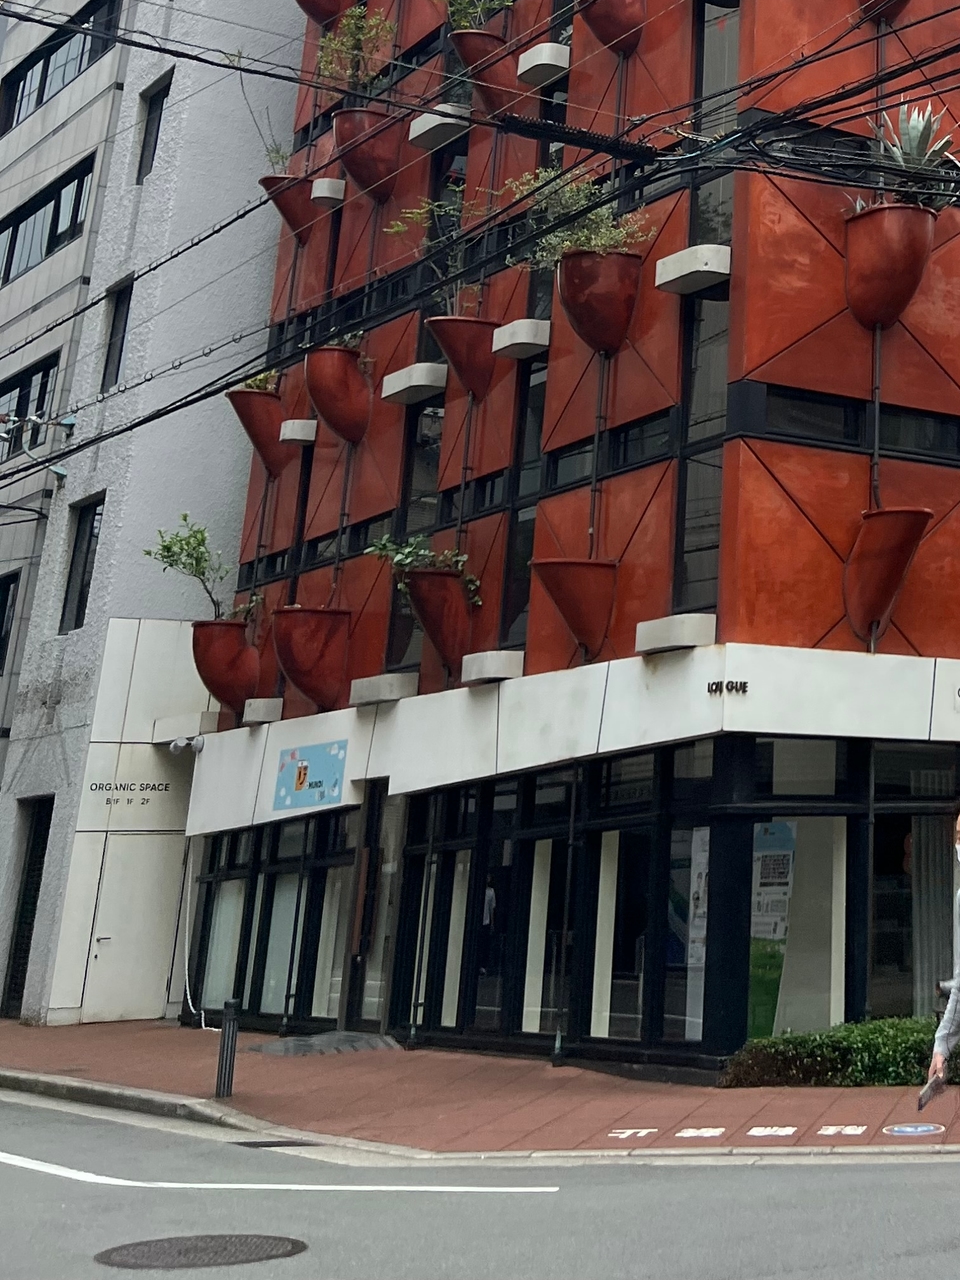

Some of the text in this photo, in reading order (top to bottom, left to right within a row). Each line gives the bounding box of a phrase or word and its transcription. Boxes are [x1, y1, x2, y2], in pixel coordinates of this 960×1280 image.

[89, 782, 171, 792] ORGANIC SPACE
[105, 797, 120, 805] B1F
[140, 797, 151, 805] 2F
